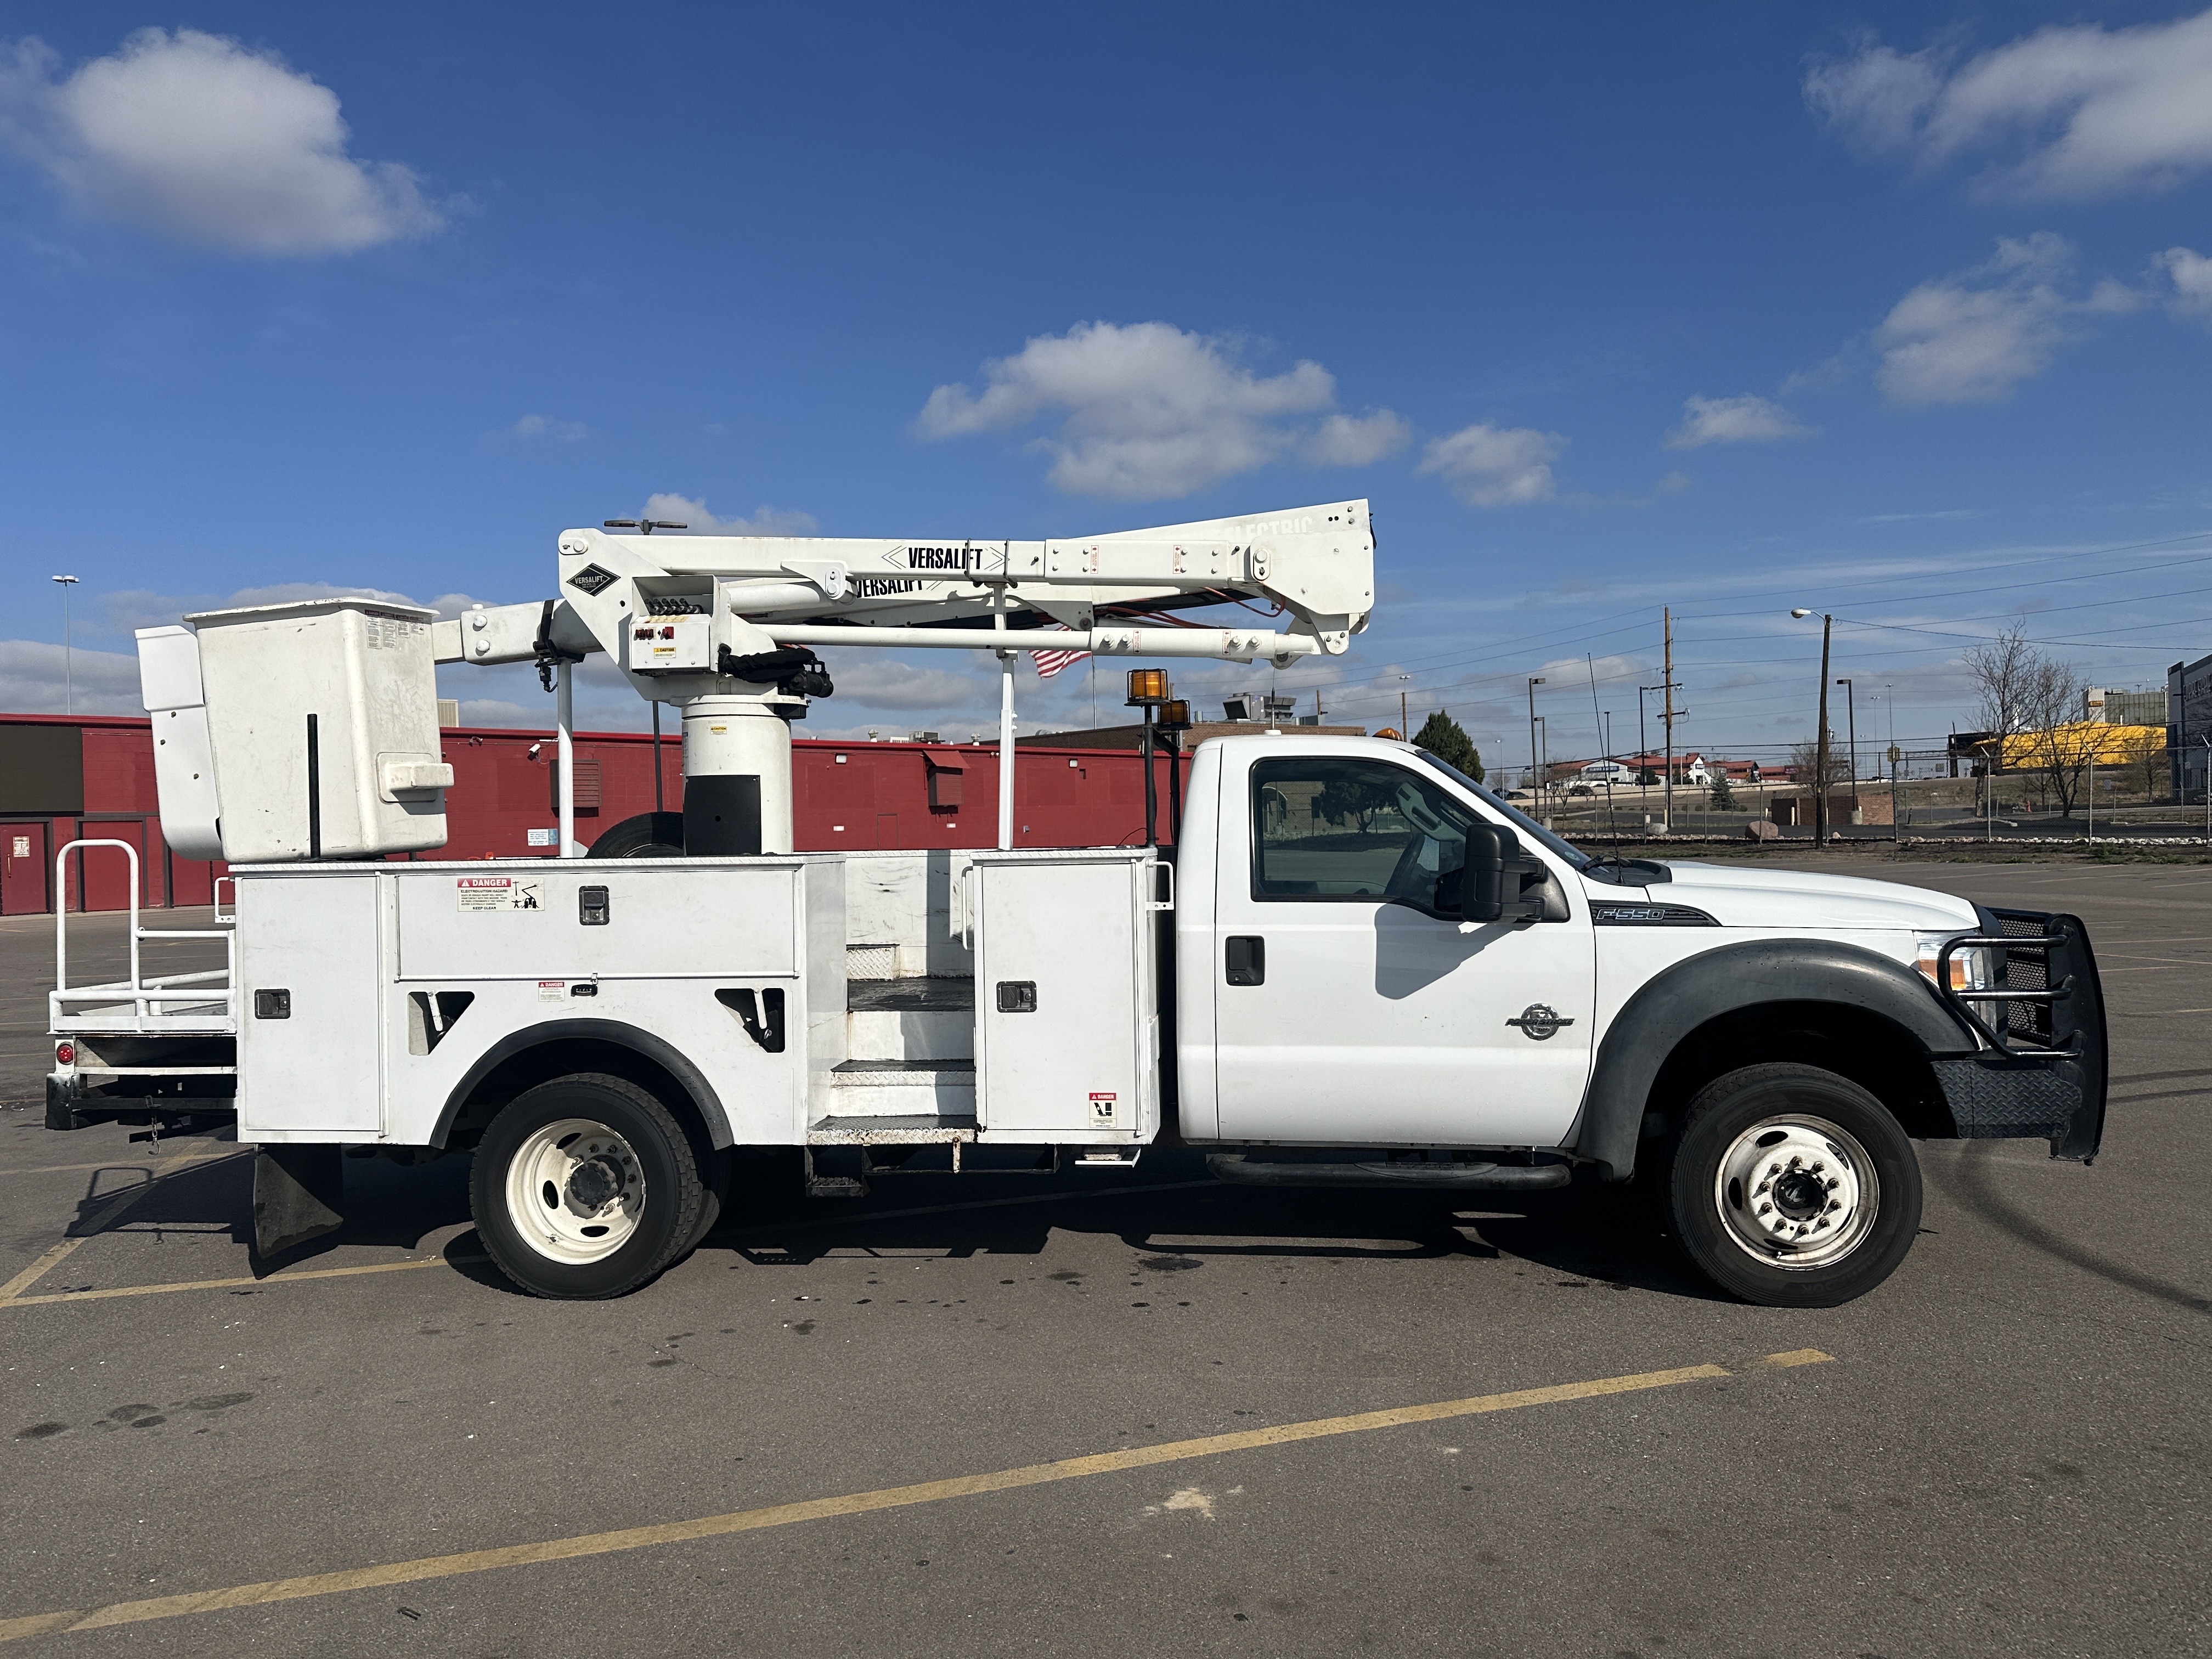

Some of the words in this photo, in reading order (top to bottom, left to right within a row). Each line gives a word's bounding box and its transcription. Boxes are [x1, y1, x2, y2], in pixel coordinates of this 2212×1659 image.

[909, 547, 983, 569] VERSALIFT
[574, 575, 603, 584] VERSALIFT
[1595, 909, 1666, 920] F-550
